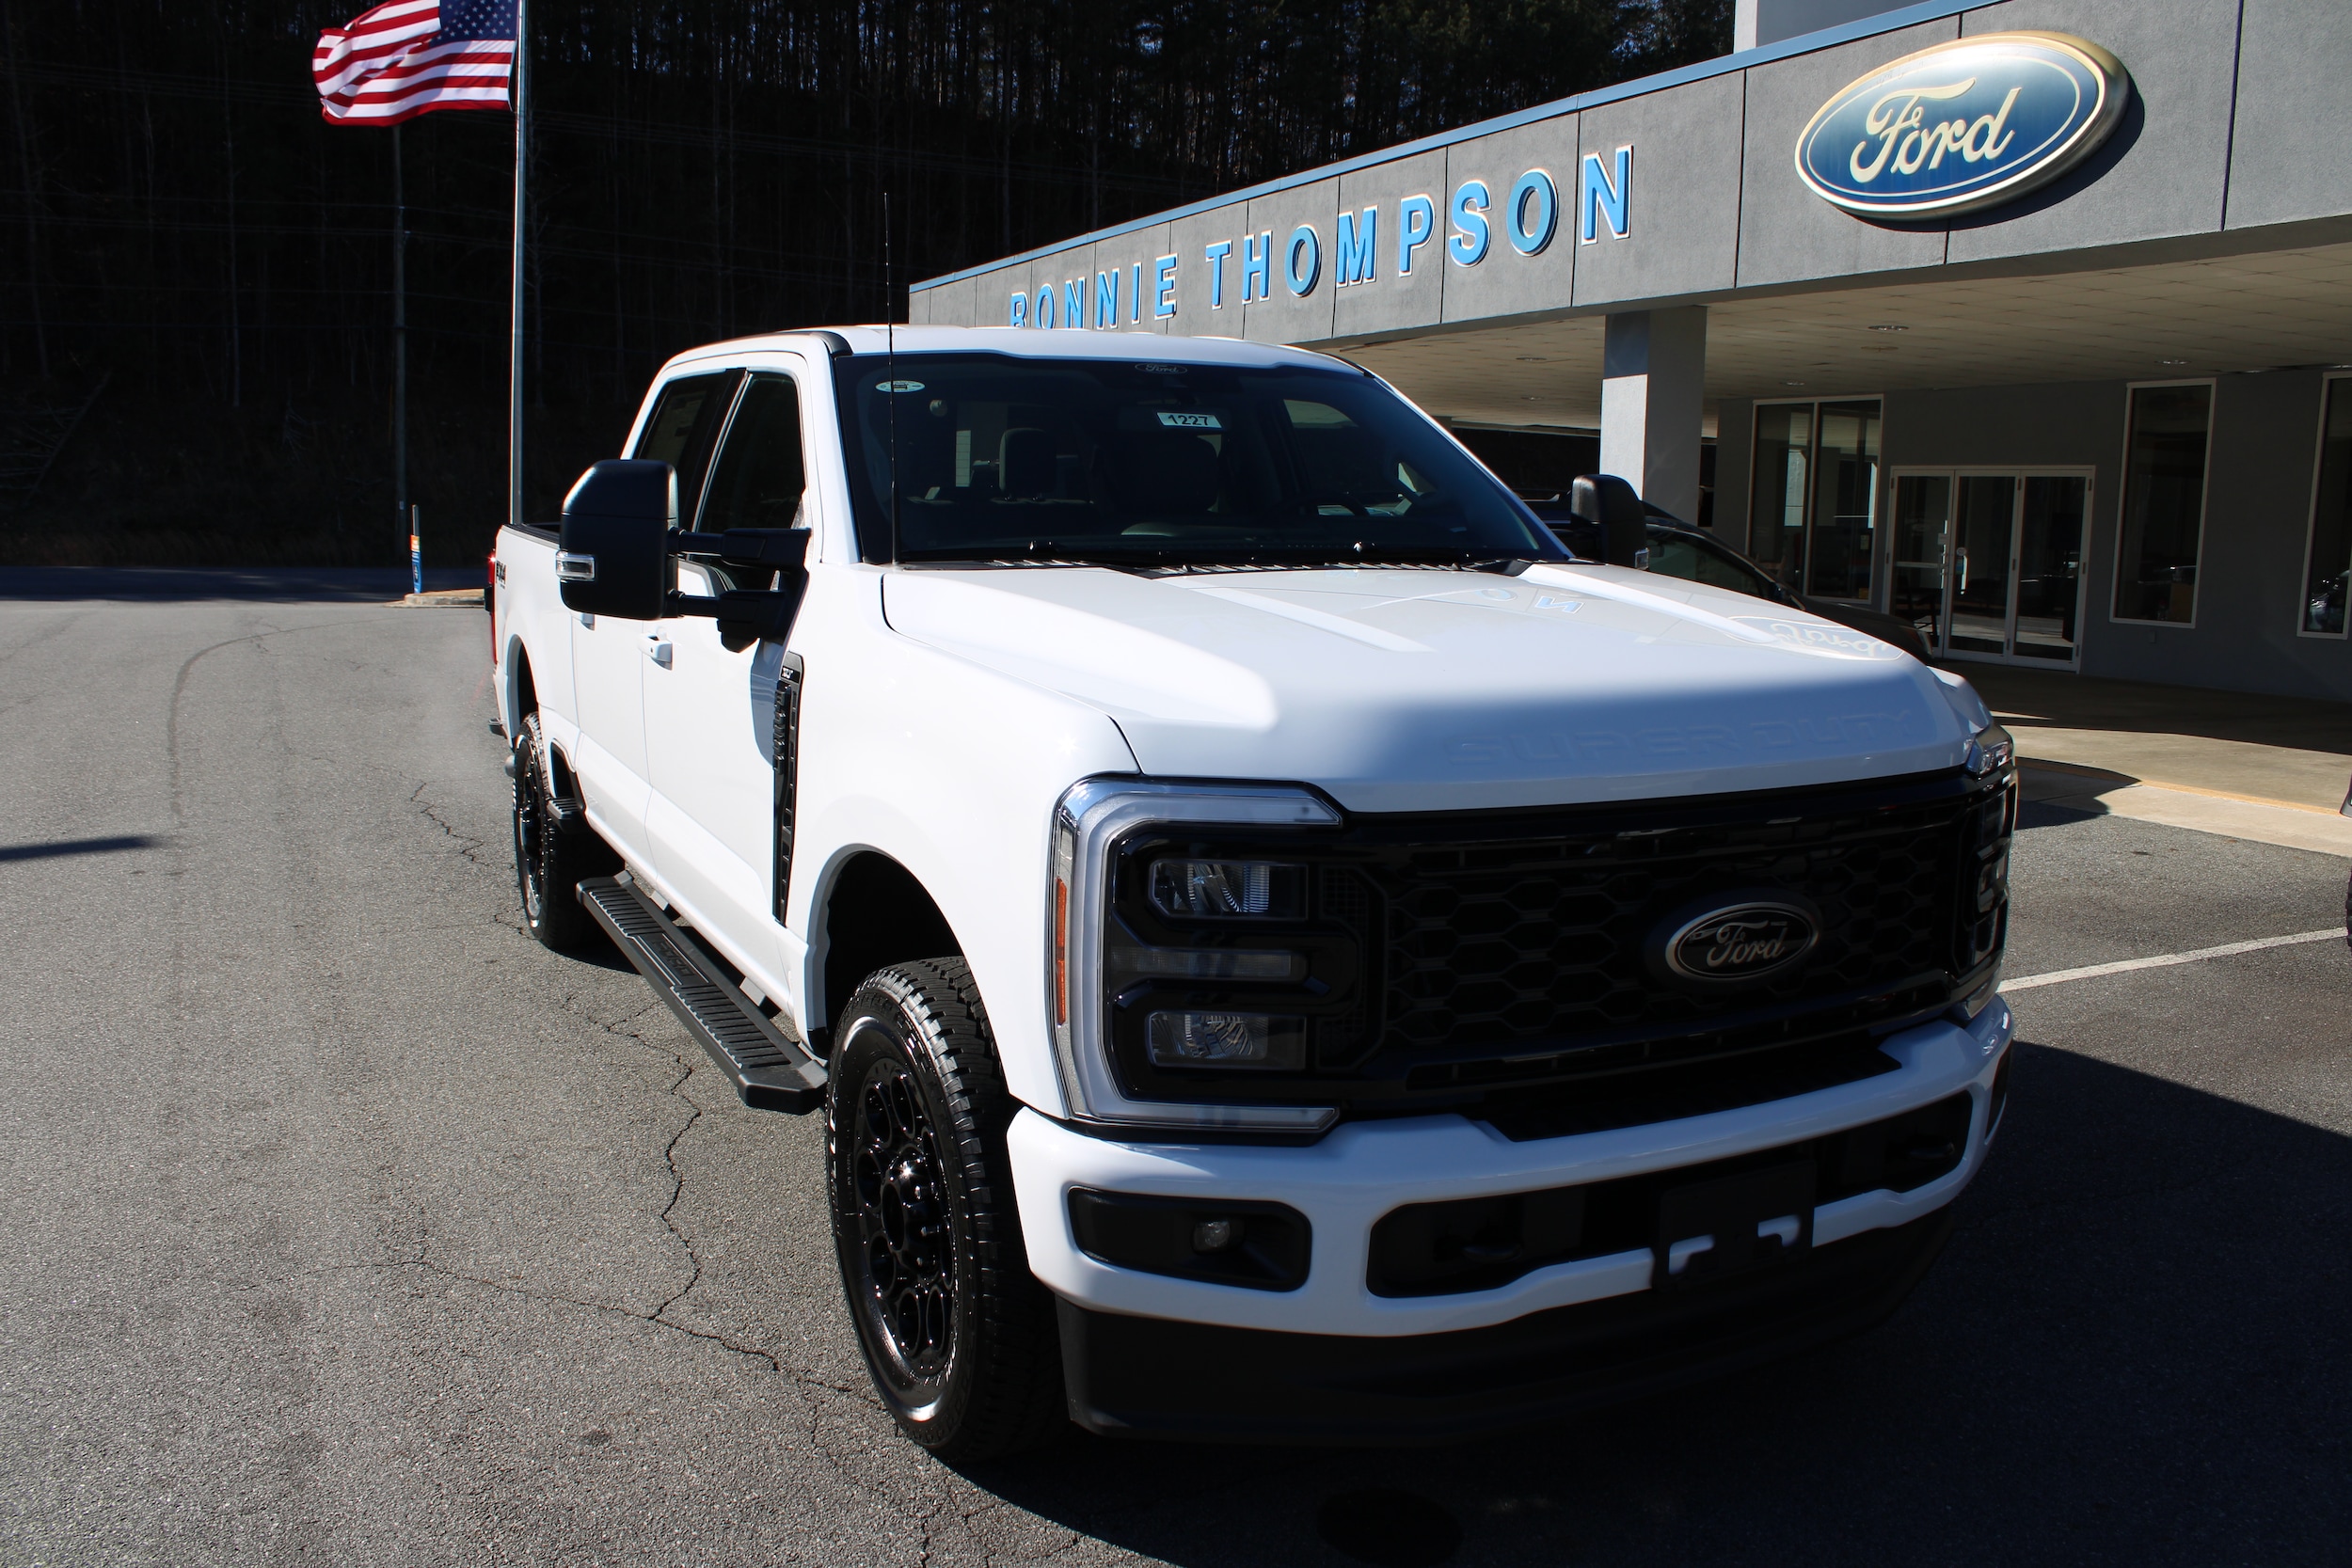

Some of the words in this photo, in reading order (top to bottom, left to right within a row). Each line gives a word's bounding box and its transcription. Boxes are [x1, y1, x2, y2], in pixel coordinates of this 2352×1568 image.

[1849, 77, 2022, 183] Ford
[1009, 252, 1178, 330] RONNIE
[1205, 144, 1633, 310] THOMPSON
[1145, 363, 1179, 373] Ford
[1168, 414, 1209, 426] 1227
[1444, 723, 1746, 766] SUPER
[1750, 709, 1912, 750] DUTY
[1707, 920, 1788, 967] Ford
